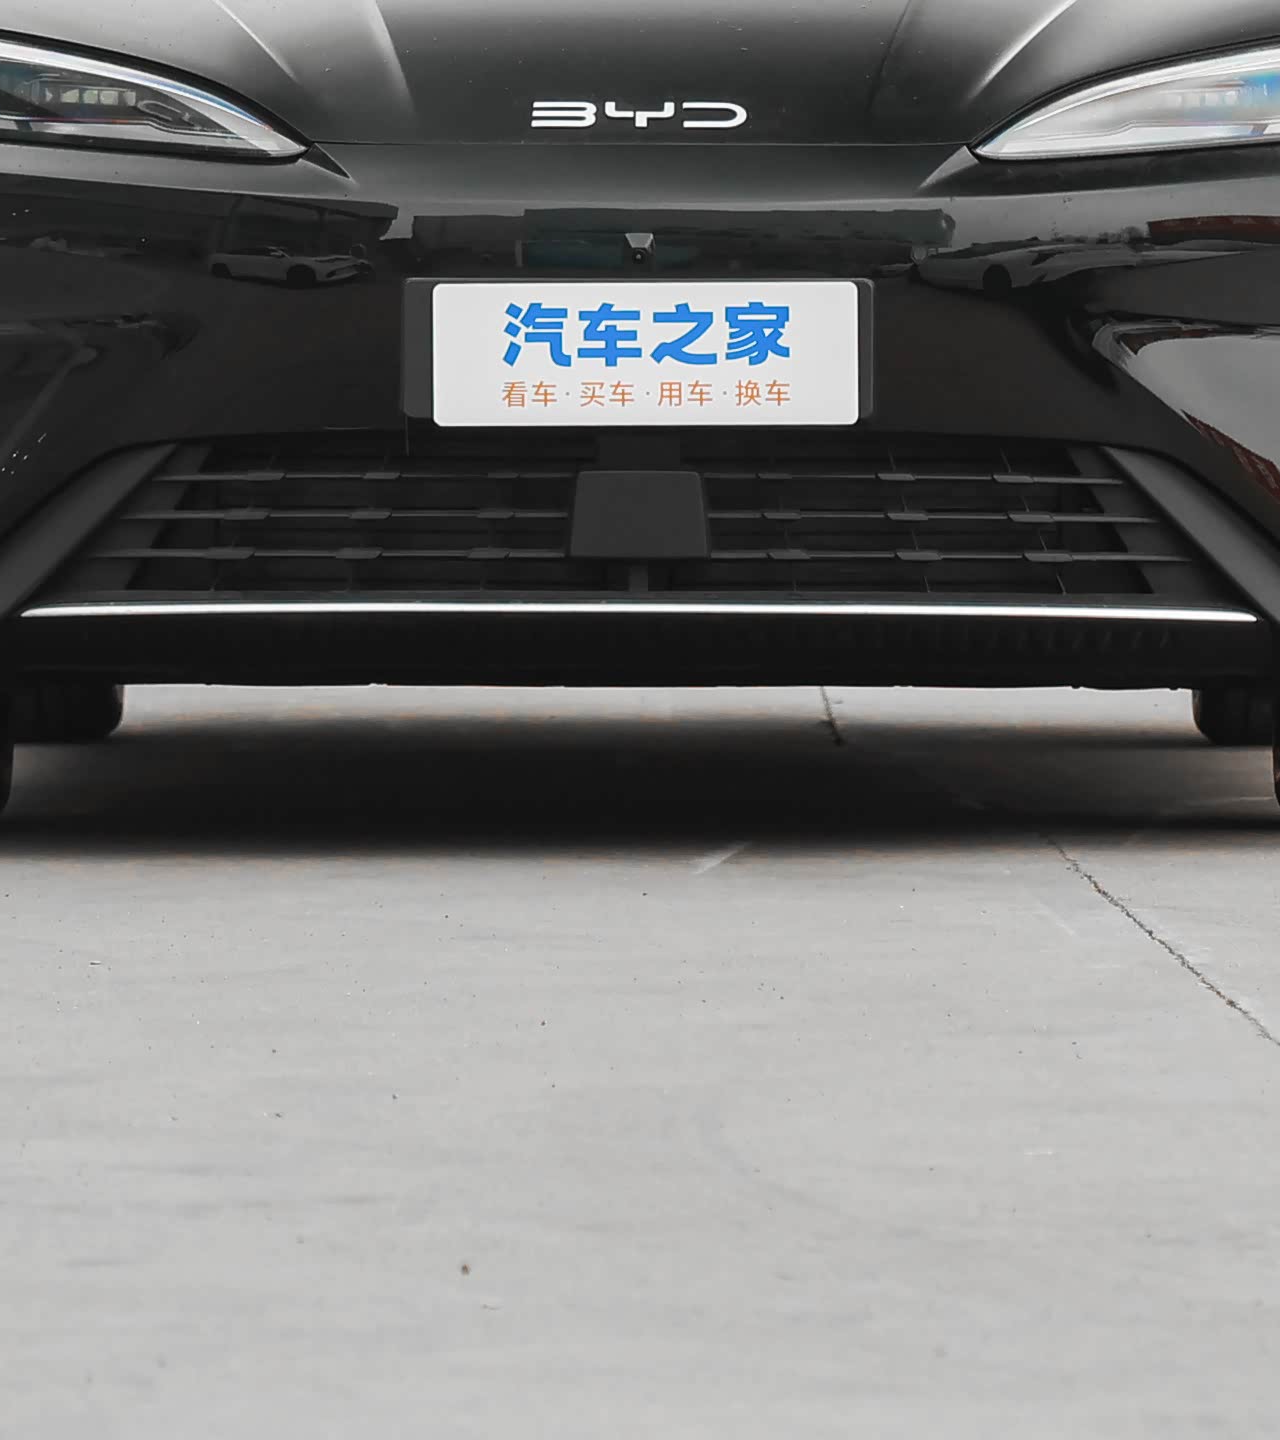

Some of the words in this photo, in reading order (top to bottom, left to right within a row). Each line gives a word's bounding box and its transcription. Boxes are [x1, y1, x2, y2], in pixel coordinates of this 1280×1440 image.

[530, 101, 748, 128] BYD
[502, 300, 791, 368] 汽车之家
